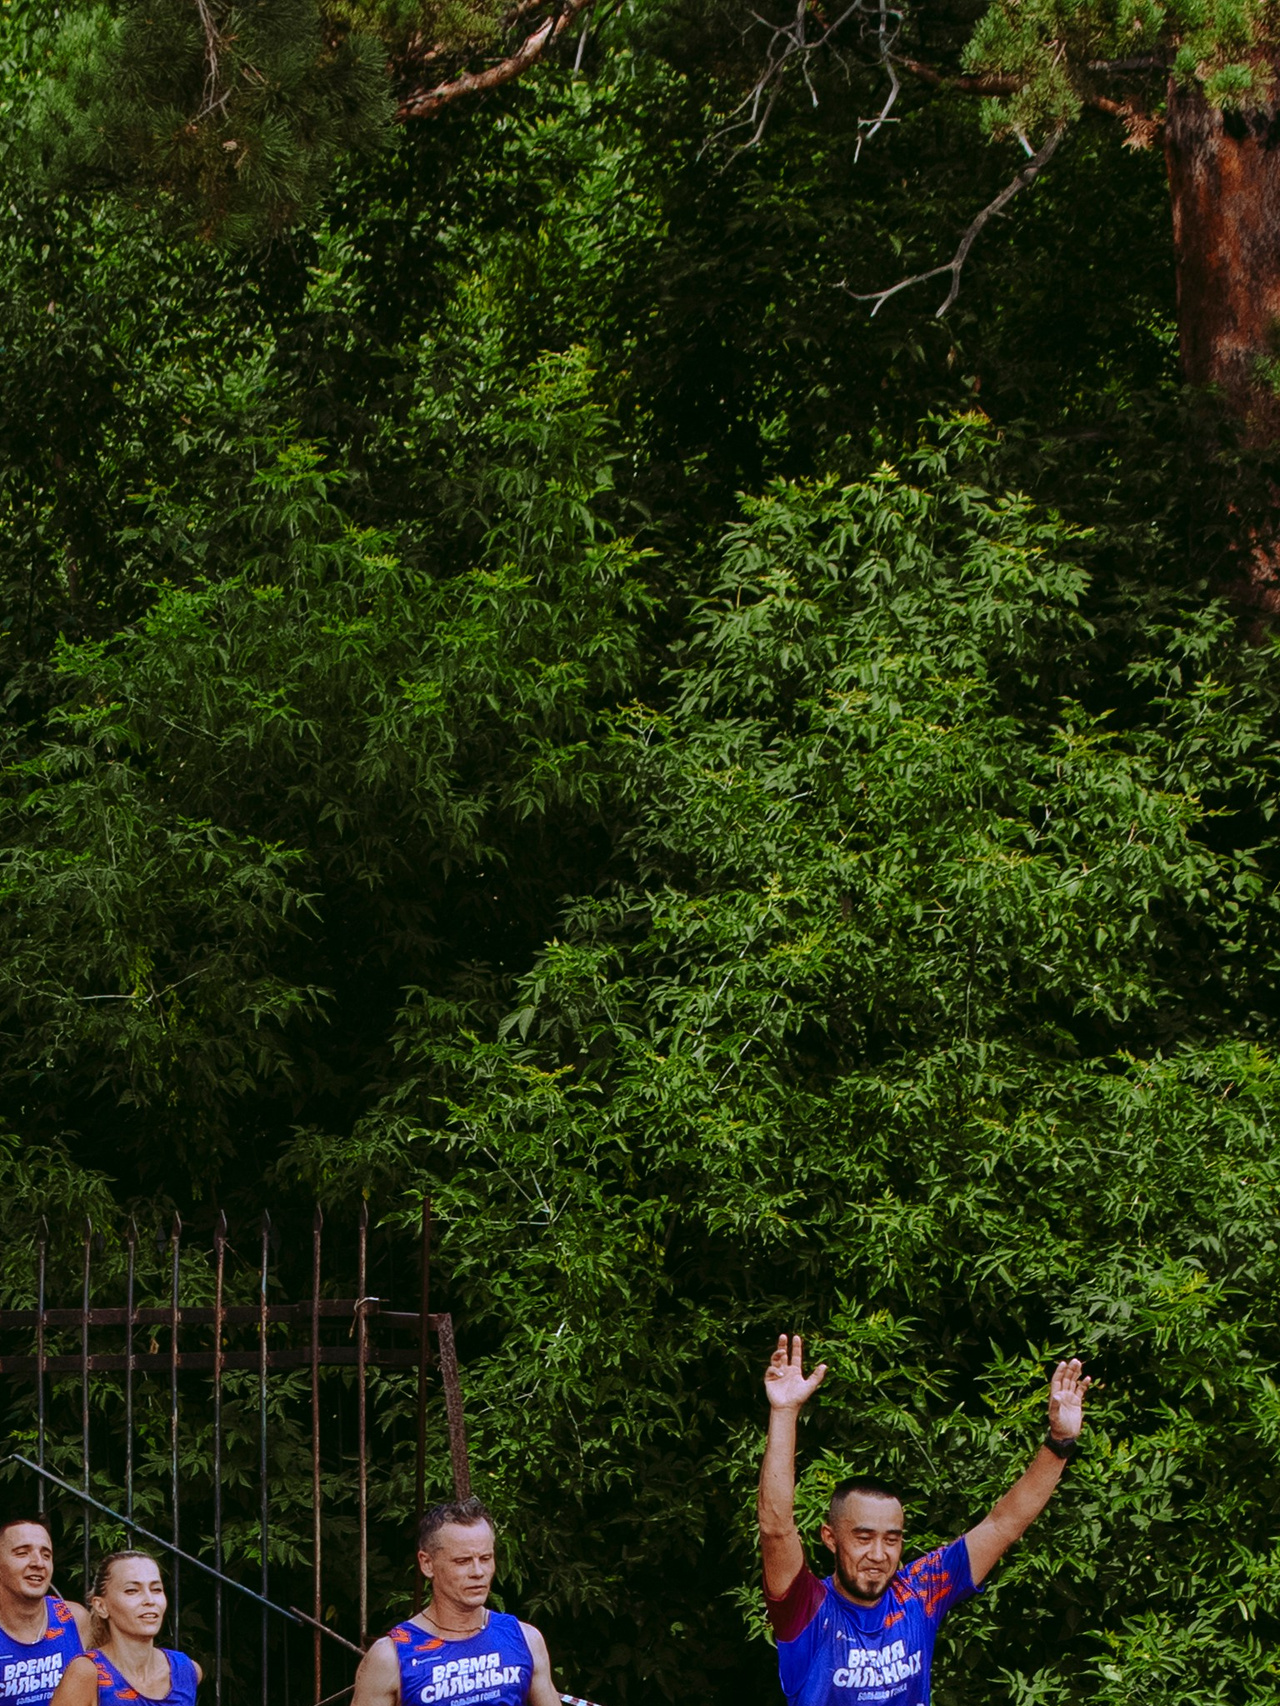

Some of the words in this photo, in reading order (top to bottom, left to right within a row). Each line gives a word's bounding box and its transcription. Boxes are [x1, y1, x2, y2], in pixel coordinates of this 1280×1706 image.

[3, 1652, 63, 1681] ВРЕМЯ
[432, 1652, 499, 1683] ВРЕМЯ
[833, 1650, 921, 1688] СИЛЬНЫХ
[848, 1639, 905, 1668] ВРЕМЯ
[420, 1666, 521, 1703] СИЛЬНЫХ
